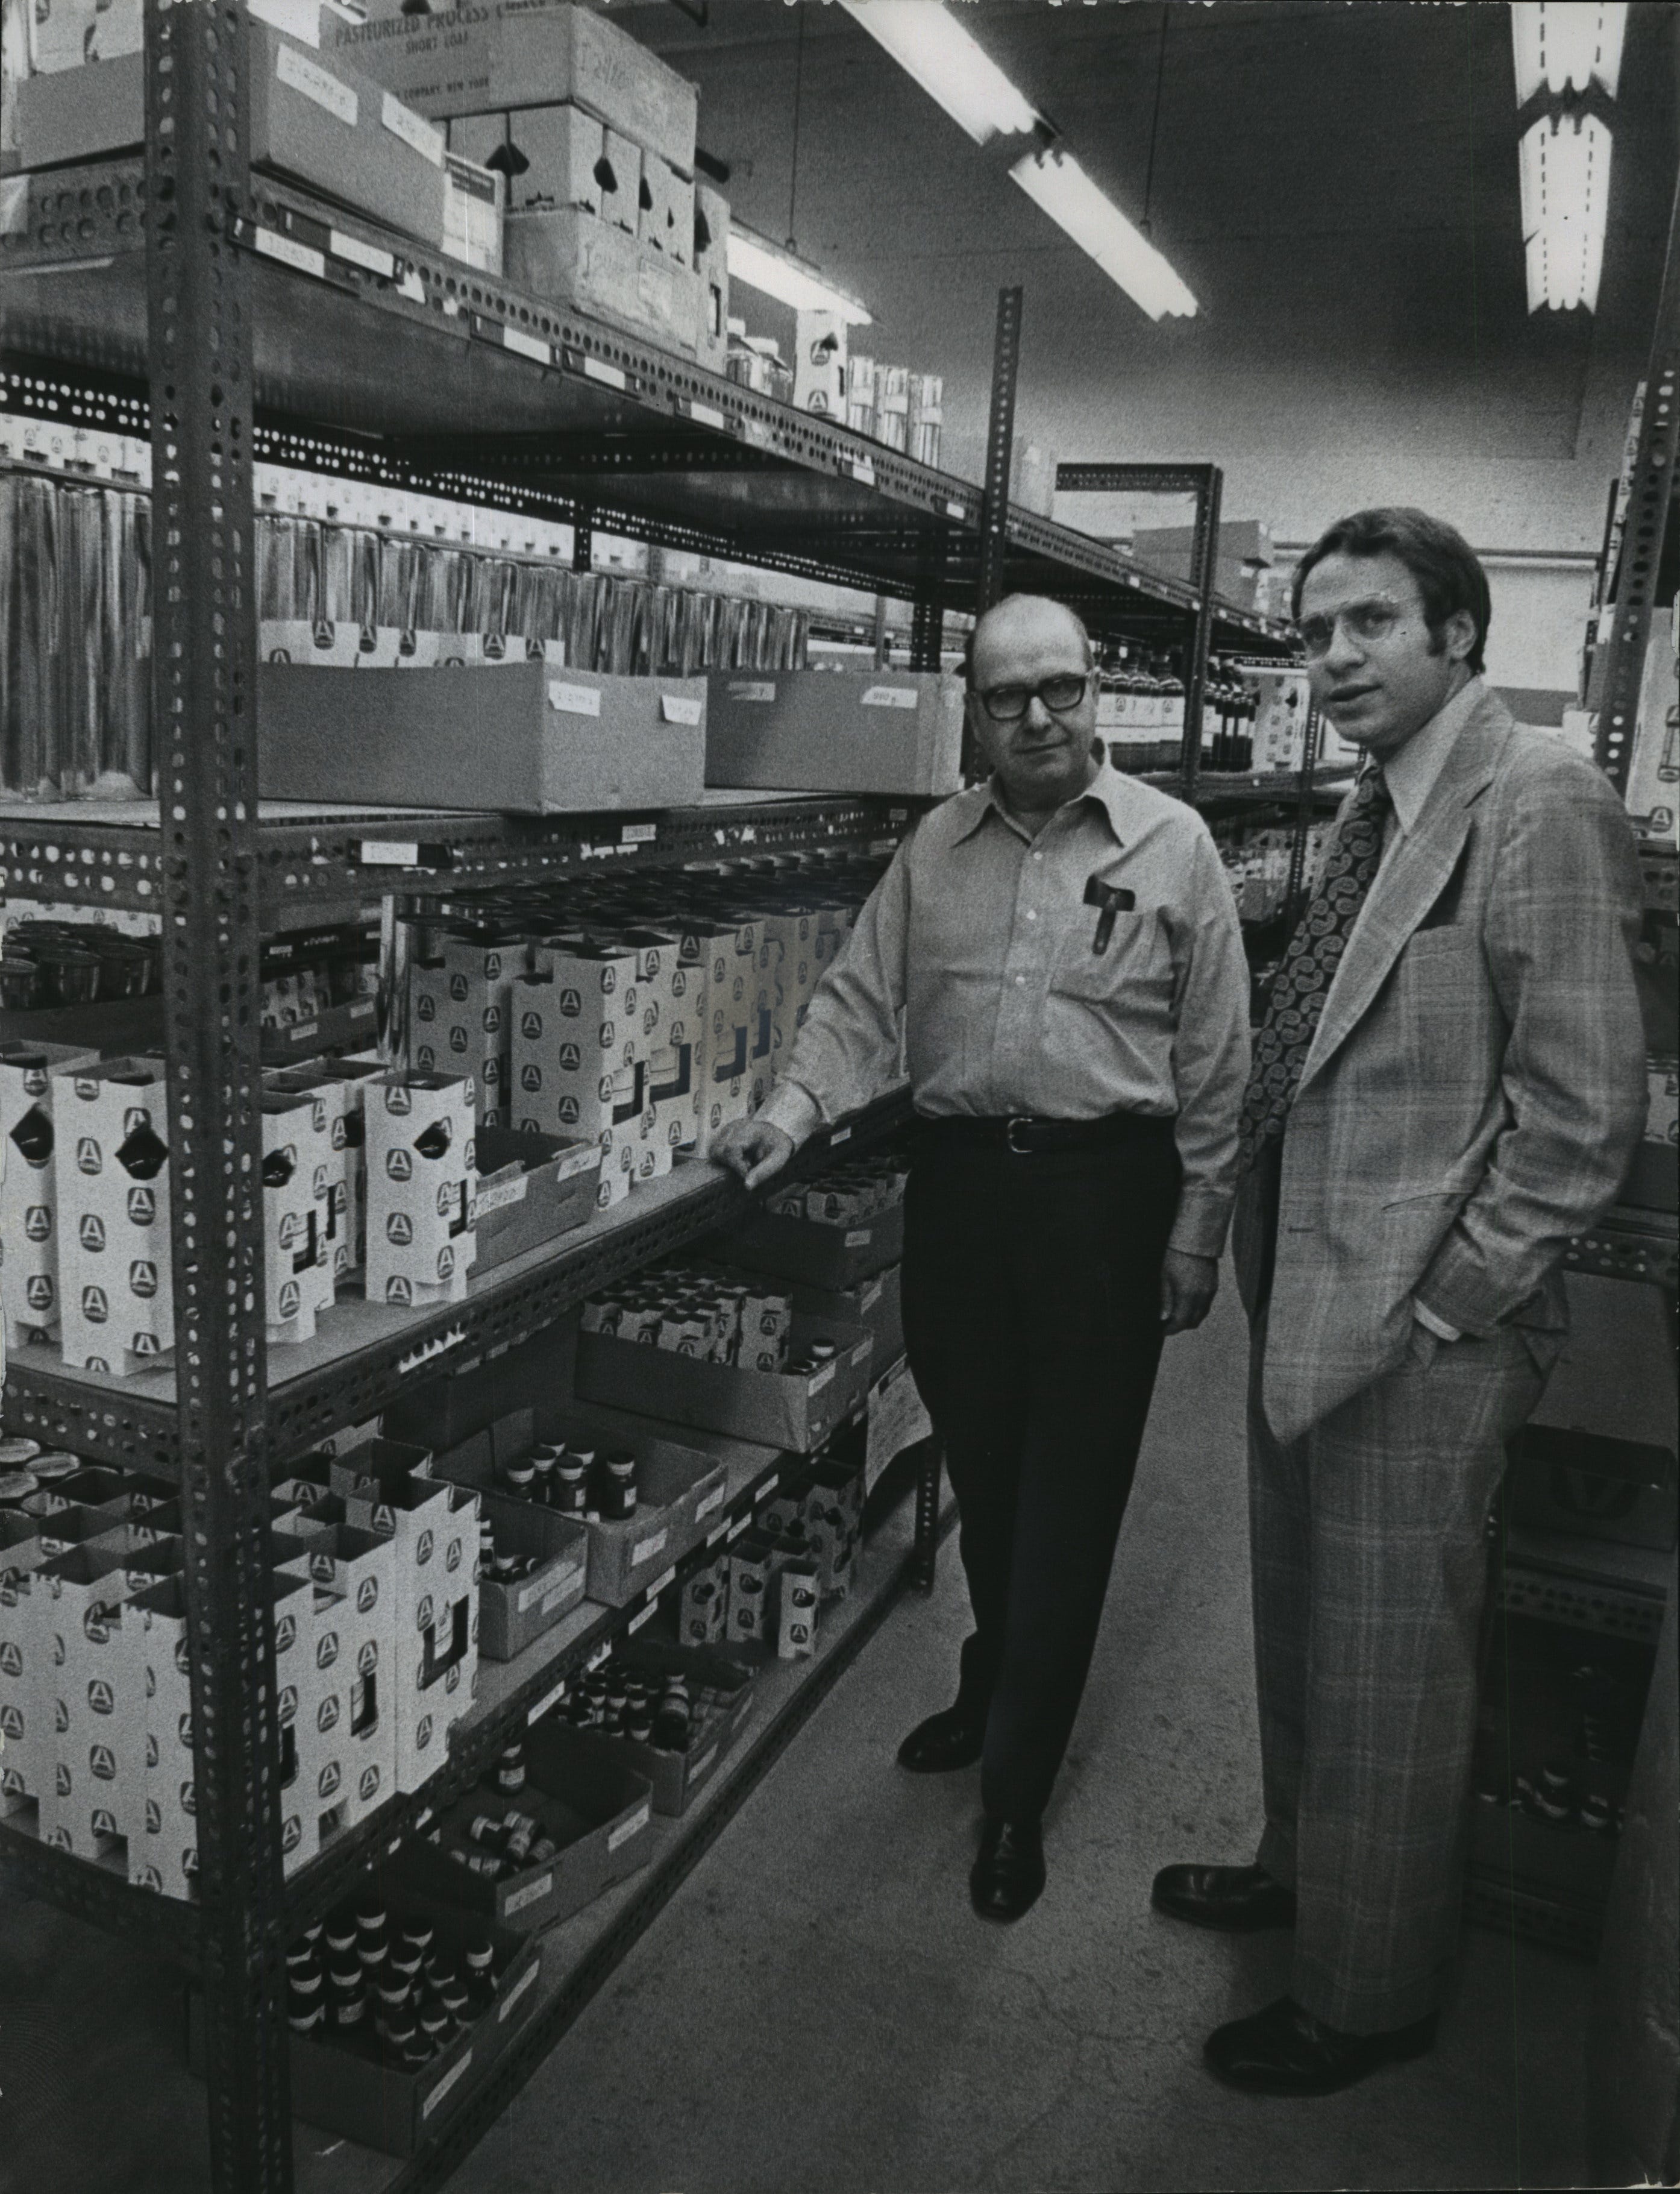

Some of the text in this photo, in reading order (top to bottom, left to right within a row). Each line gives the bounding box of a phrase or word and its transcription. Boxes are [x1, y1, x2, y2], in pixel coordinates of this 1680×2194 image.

[336, 16, 420, 47] PASTEURIZED
[428, 8, 489, 30] PROCESS
[406, 36, 438, 54] SHORT
[404, 86, 440, 99] COMPANY
[447, 83, 463, 93] NEW
[468, 77, 489, 89] YORK
